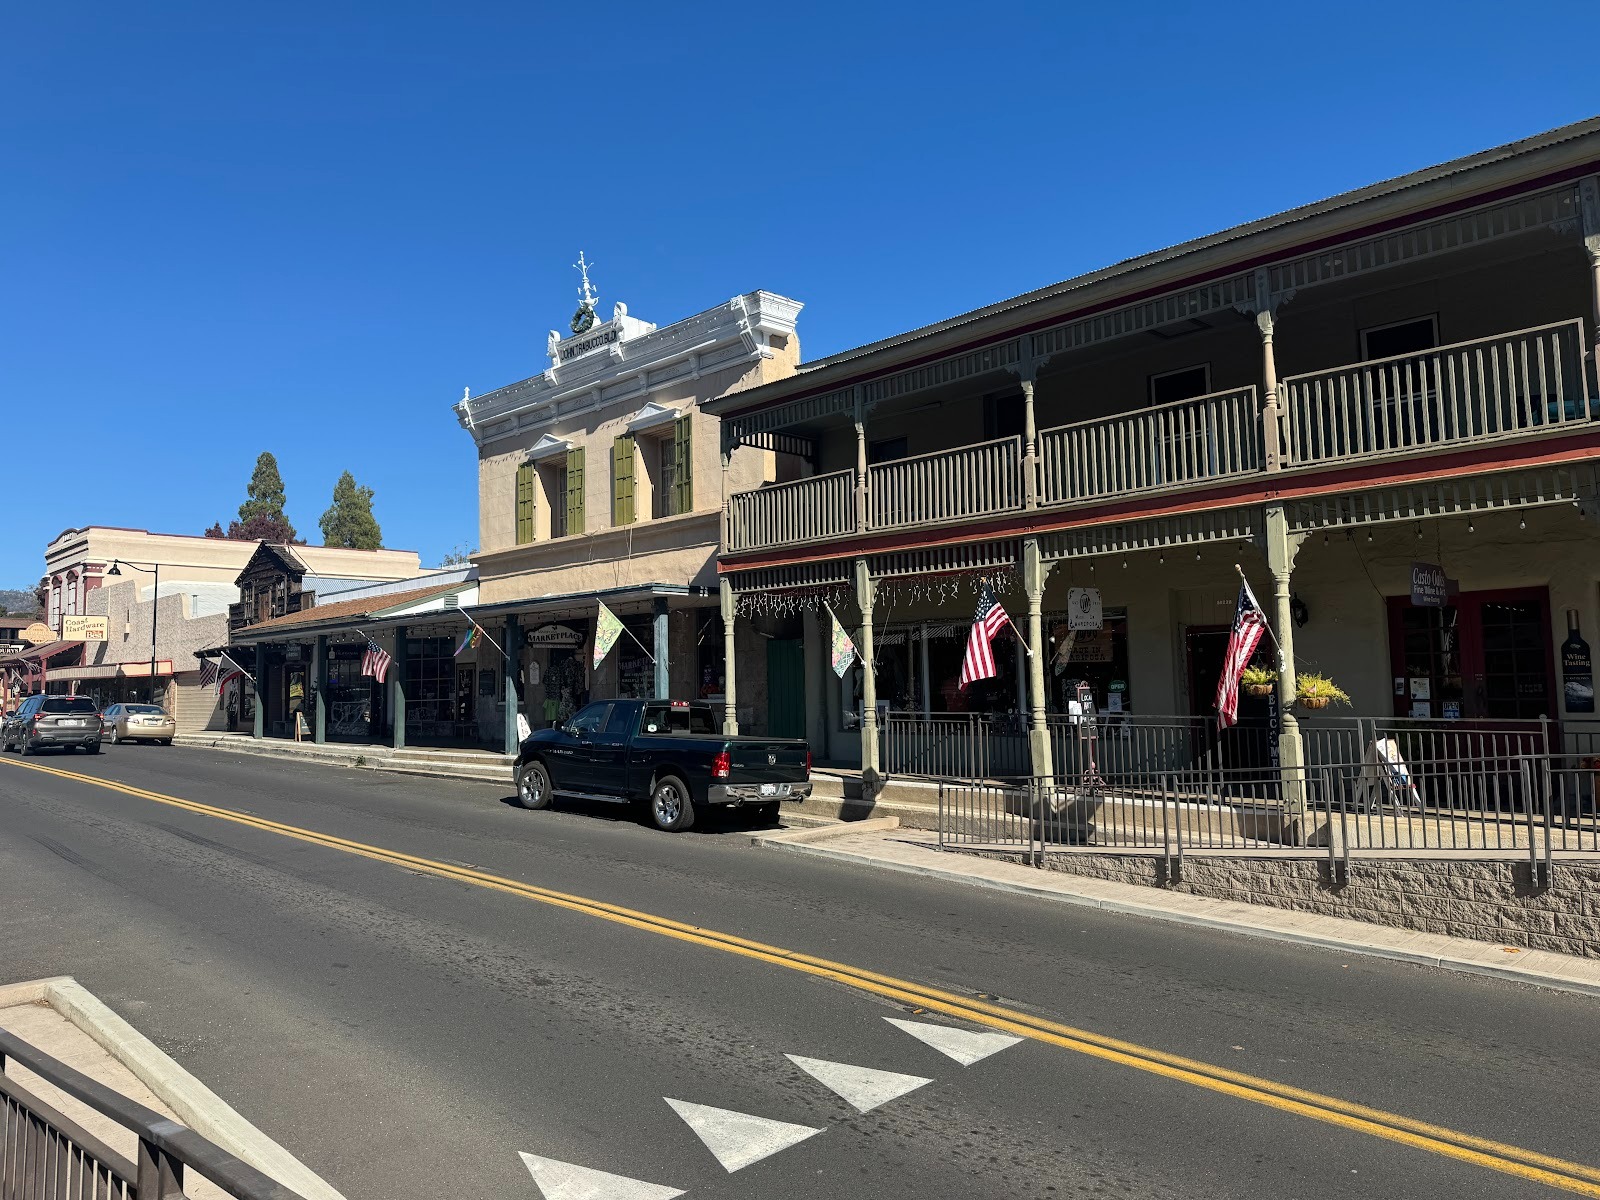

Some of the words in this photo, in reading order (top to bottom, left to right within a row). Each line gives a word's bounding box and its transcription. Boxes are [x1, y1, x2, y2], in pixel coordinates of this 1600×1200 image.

[576, 336, 603, 355] TRABUCCO
[1413, 567, 1431, 586] Casto
[1432, 569, 1445, 588] Oaks
[1414, 585, 1424, 595] Fine
[1424, 585, 1436, 595] Wine
[65, 617, 88, 627] Coast
[65, 622, 105, 633] Hardware
[528, 632, 583, 642] MARKETPLACE
[1563, 659, 1590, 667] Tasting
